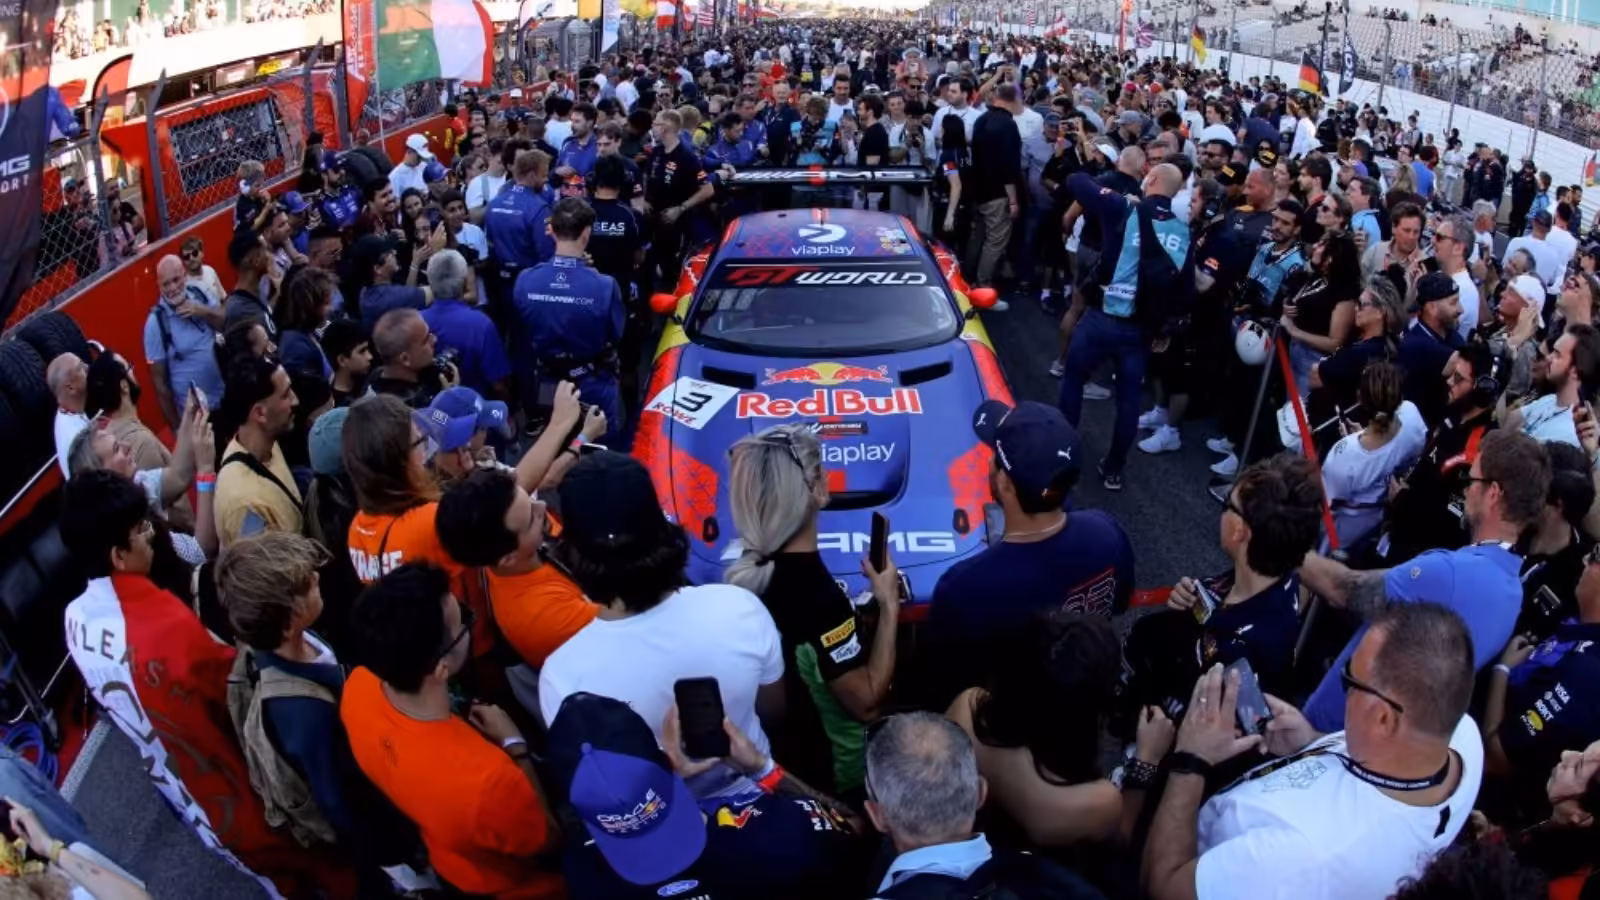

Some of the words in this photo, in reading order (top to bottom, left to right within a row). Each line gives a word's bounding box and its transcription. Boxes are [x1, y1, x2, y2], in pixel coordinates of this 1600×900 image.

[791, 244, 855, 256] viaplay
[727, 267, 822, 286] GT
[796, 271, 927, 285] WORLD
[671, 392, 713, 412] 3
[736, 389, 829, 418] Red
[832, 388, 922, 415] Bull
[652, 402, 697, 424] ROWE
[821, 442, 895, 465] iaplay
[1555, 682, 1570, 703] VISA
